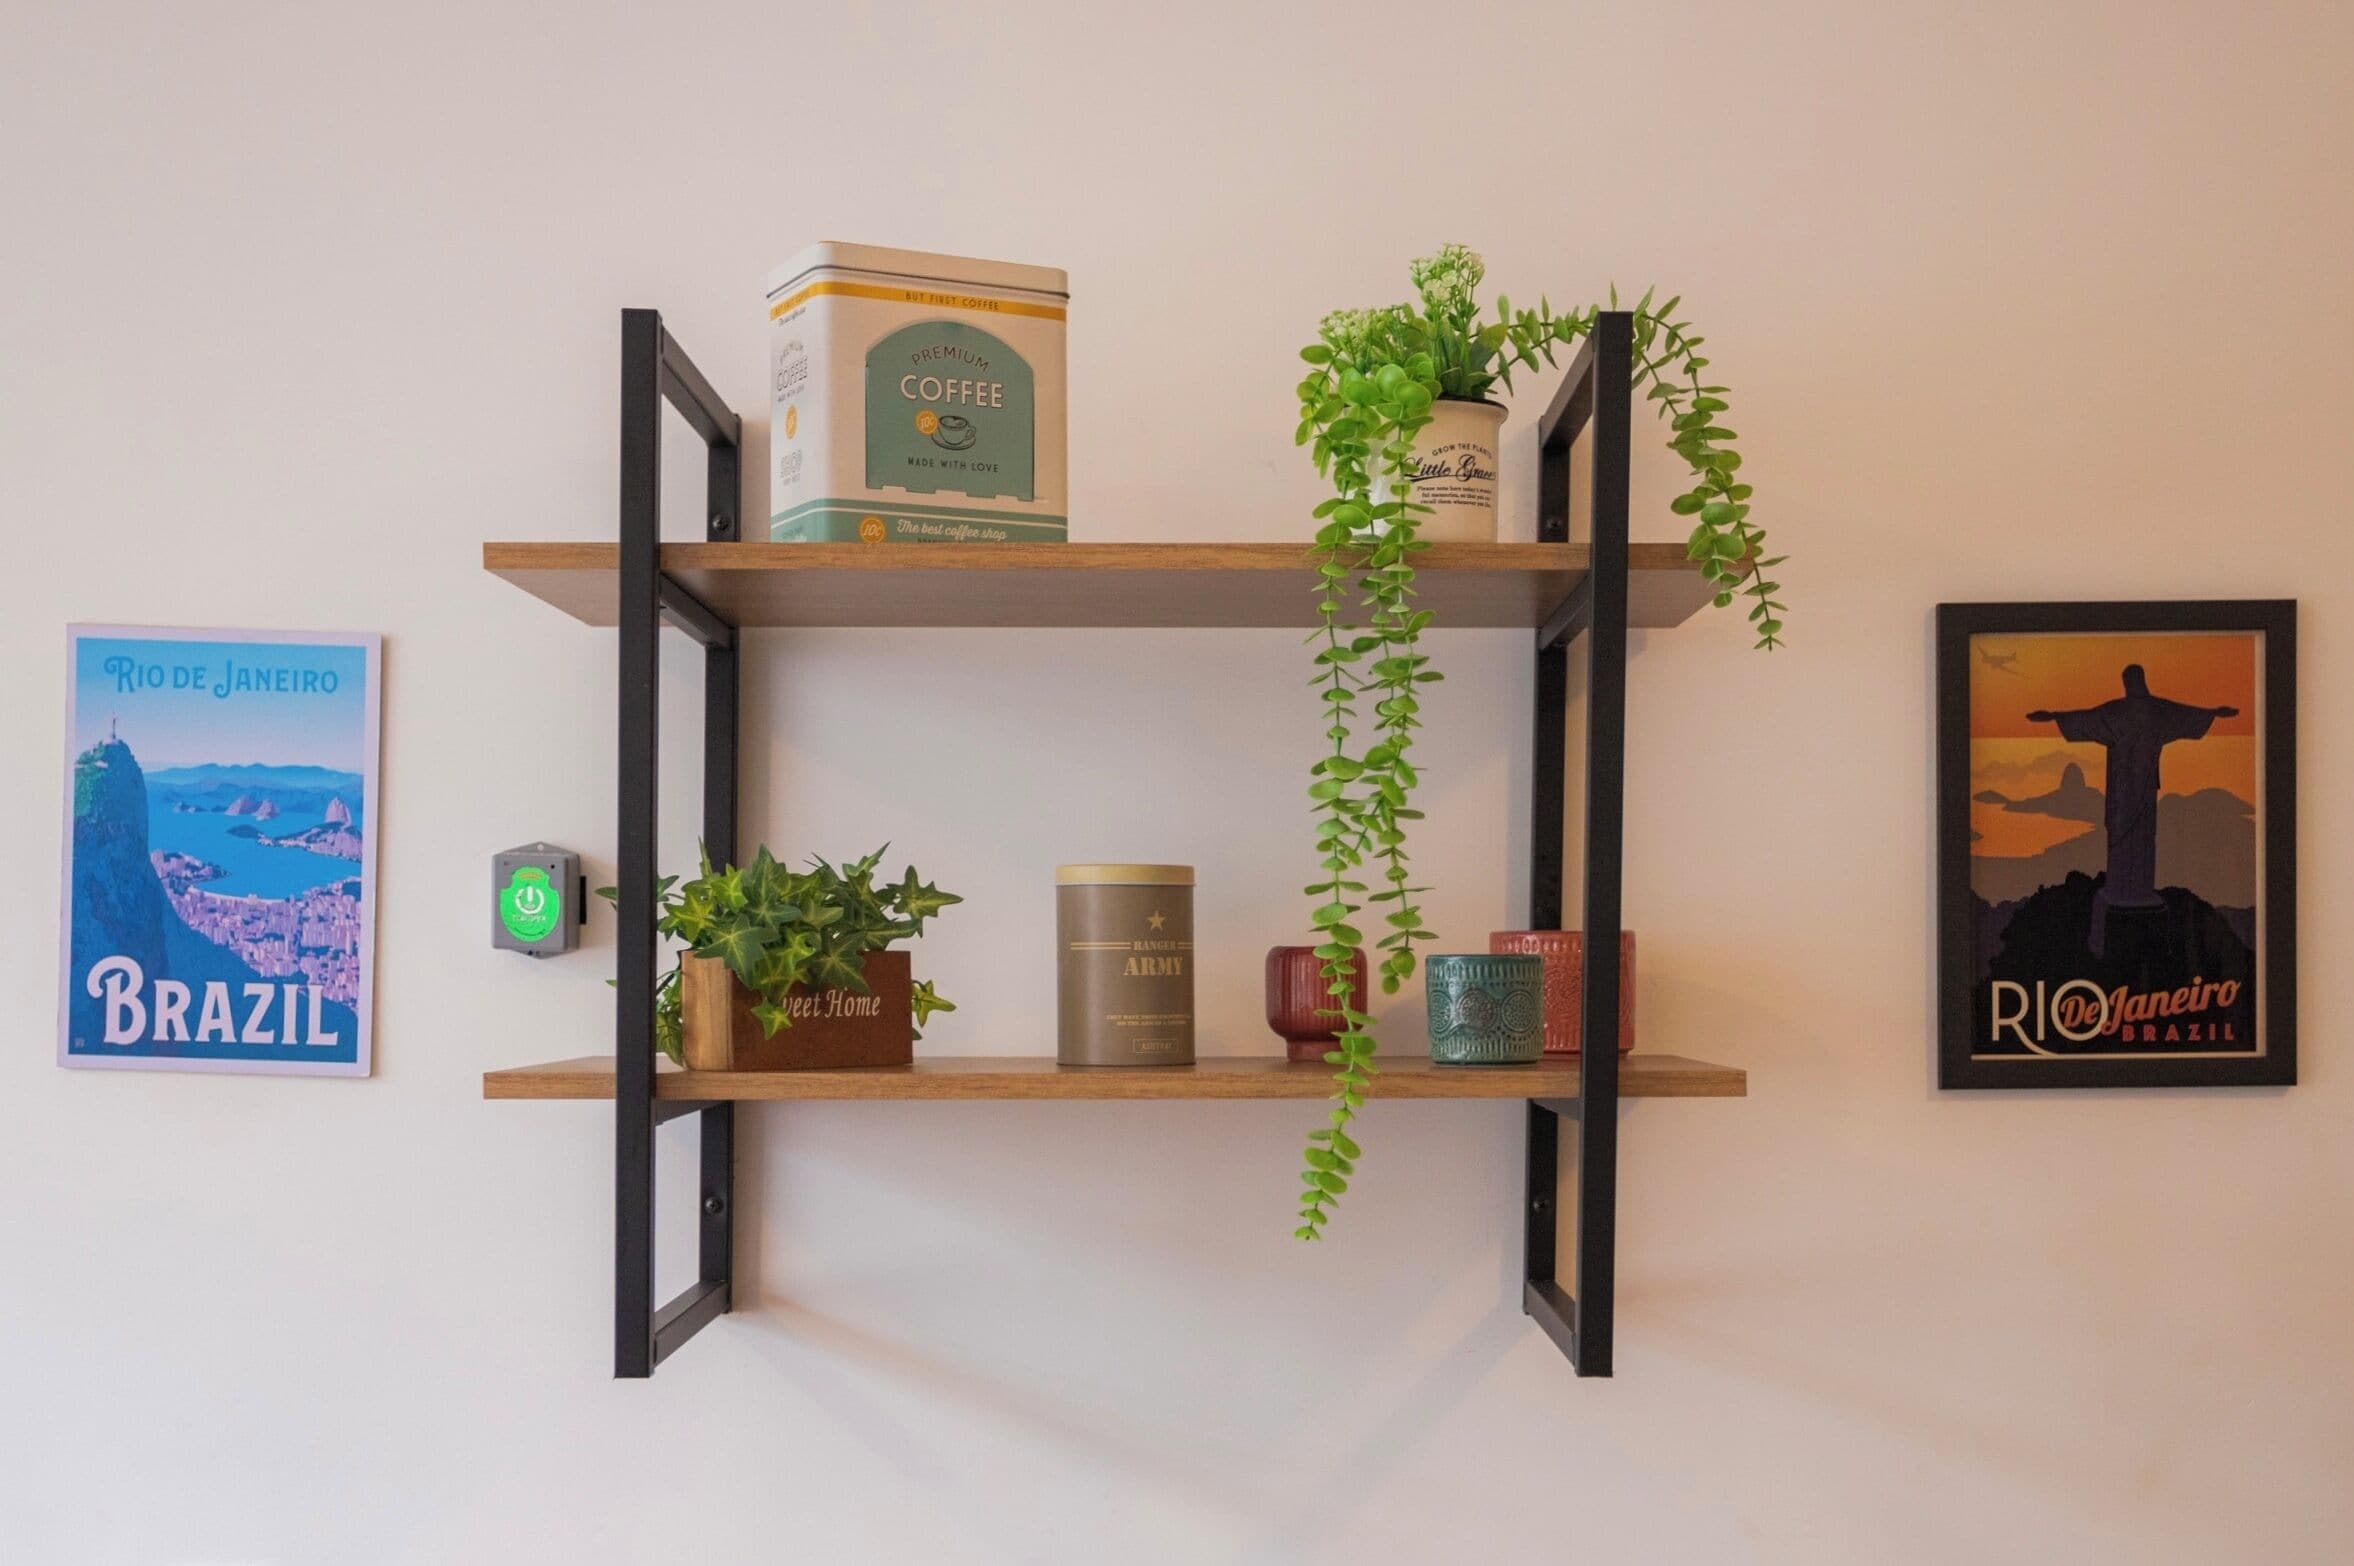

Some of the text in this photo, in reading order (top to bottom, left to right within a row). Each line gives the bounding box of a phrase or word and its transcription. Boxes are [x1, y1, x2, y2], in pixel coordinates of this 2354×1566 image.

[905, 291, 999, 310] BUT FIRST COFFEE
[911, 346, 989, 372] PREMIUM
[900, 374, 1003, 408] COFFEE
[1432, 444, 1456, 456] GROW
[907, 457, 999, 472] MADE WITH LOVE
[897, 519, 1008, 541] The best coffee shop
[103, 655, 338, 699] RIO DE JANEIRO
[1133, 940, 1176, 950] RANGER
[1123, 957, 1183, 976] ARMY
[86, 955, 339, 1046] BRAZIL
[825, 987, 881, 1018] Home
[1992, 976, 2241, 1056] RIO De Janeiro
[2122, 1023, 2235, 1042] BRAZIL
